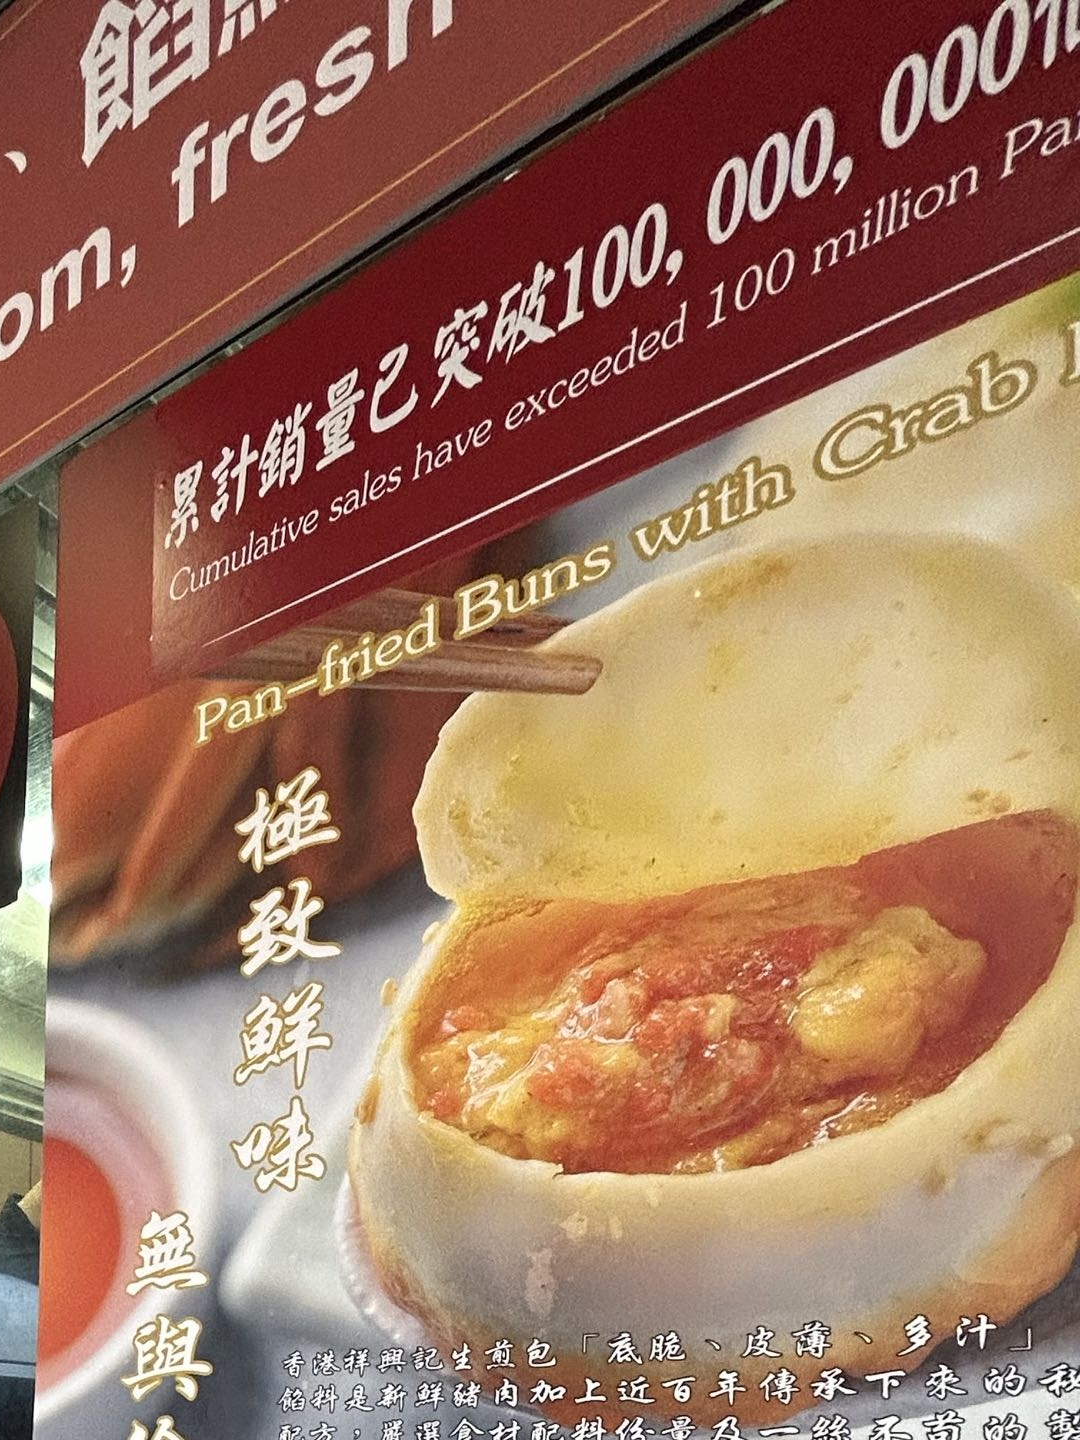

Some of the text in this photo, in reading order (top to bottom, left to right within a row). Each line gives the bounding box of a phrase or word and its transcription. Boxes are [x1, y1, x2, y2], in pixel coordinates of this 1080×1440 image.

[169, 109, 1080, 601] Cumulative sales have exceeded 100 million Pa
[455, 543, 613, 640] Buns
[632, 457, 795, 560] with
[813, 350, 1038, 481] Crab
[231, 766, 342, 1193] 極致鮮味
